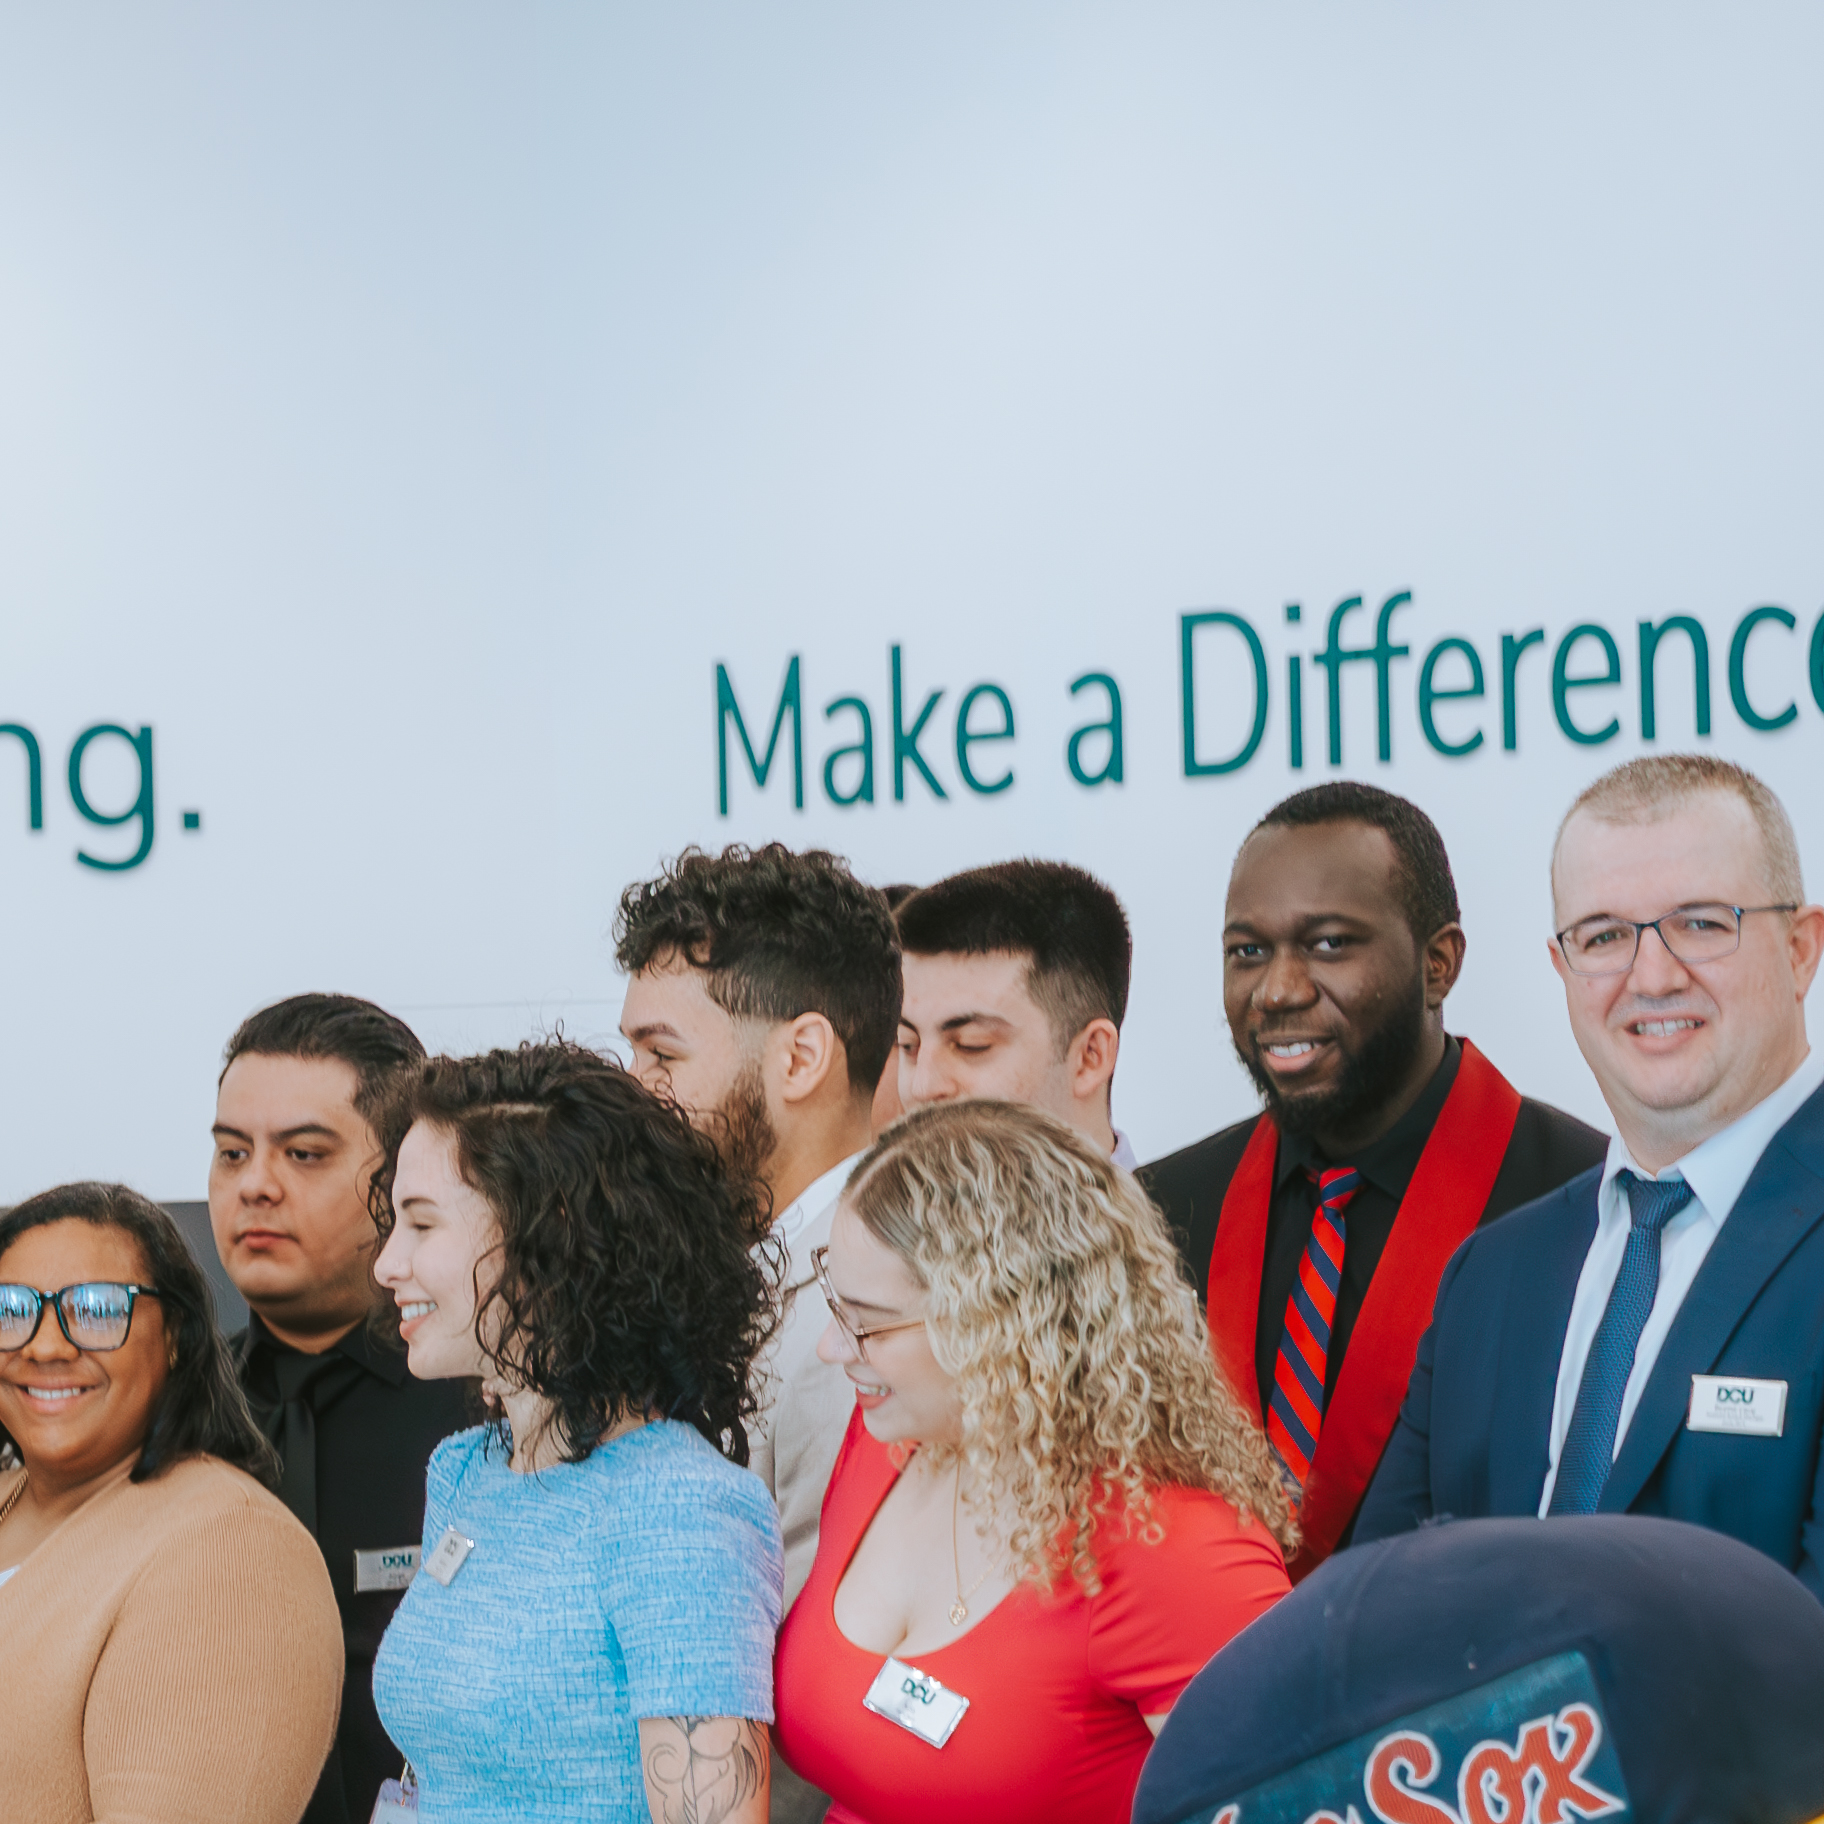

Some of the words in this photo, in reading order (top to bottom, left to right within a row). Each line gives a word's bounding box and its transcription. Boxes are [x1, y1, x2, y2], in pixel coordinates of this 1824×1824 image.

[714, 643, 1016, 818] Make
[1066, 671, 1125, 789] a
[1179, 588, 1824, 780] Differenc
[1718, 1387, 1754, 1404] DCU
[382, 1553, 412, 1568] DCU
[901, 1677, 936, 1705] DCU
